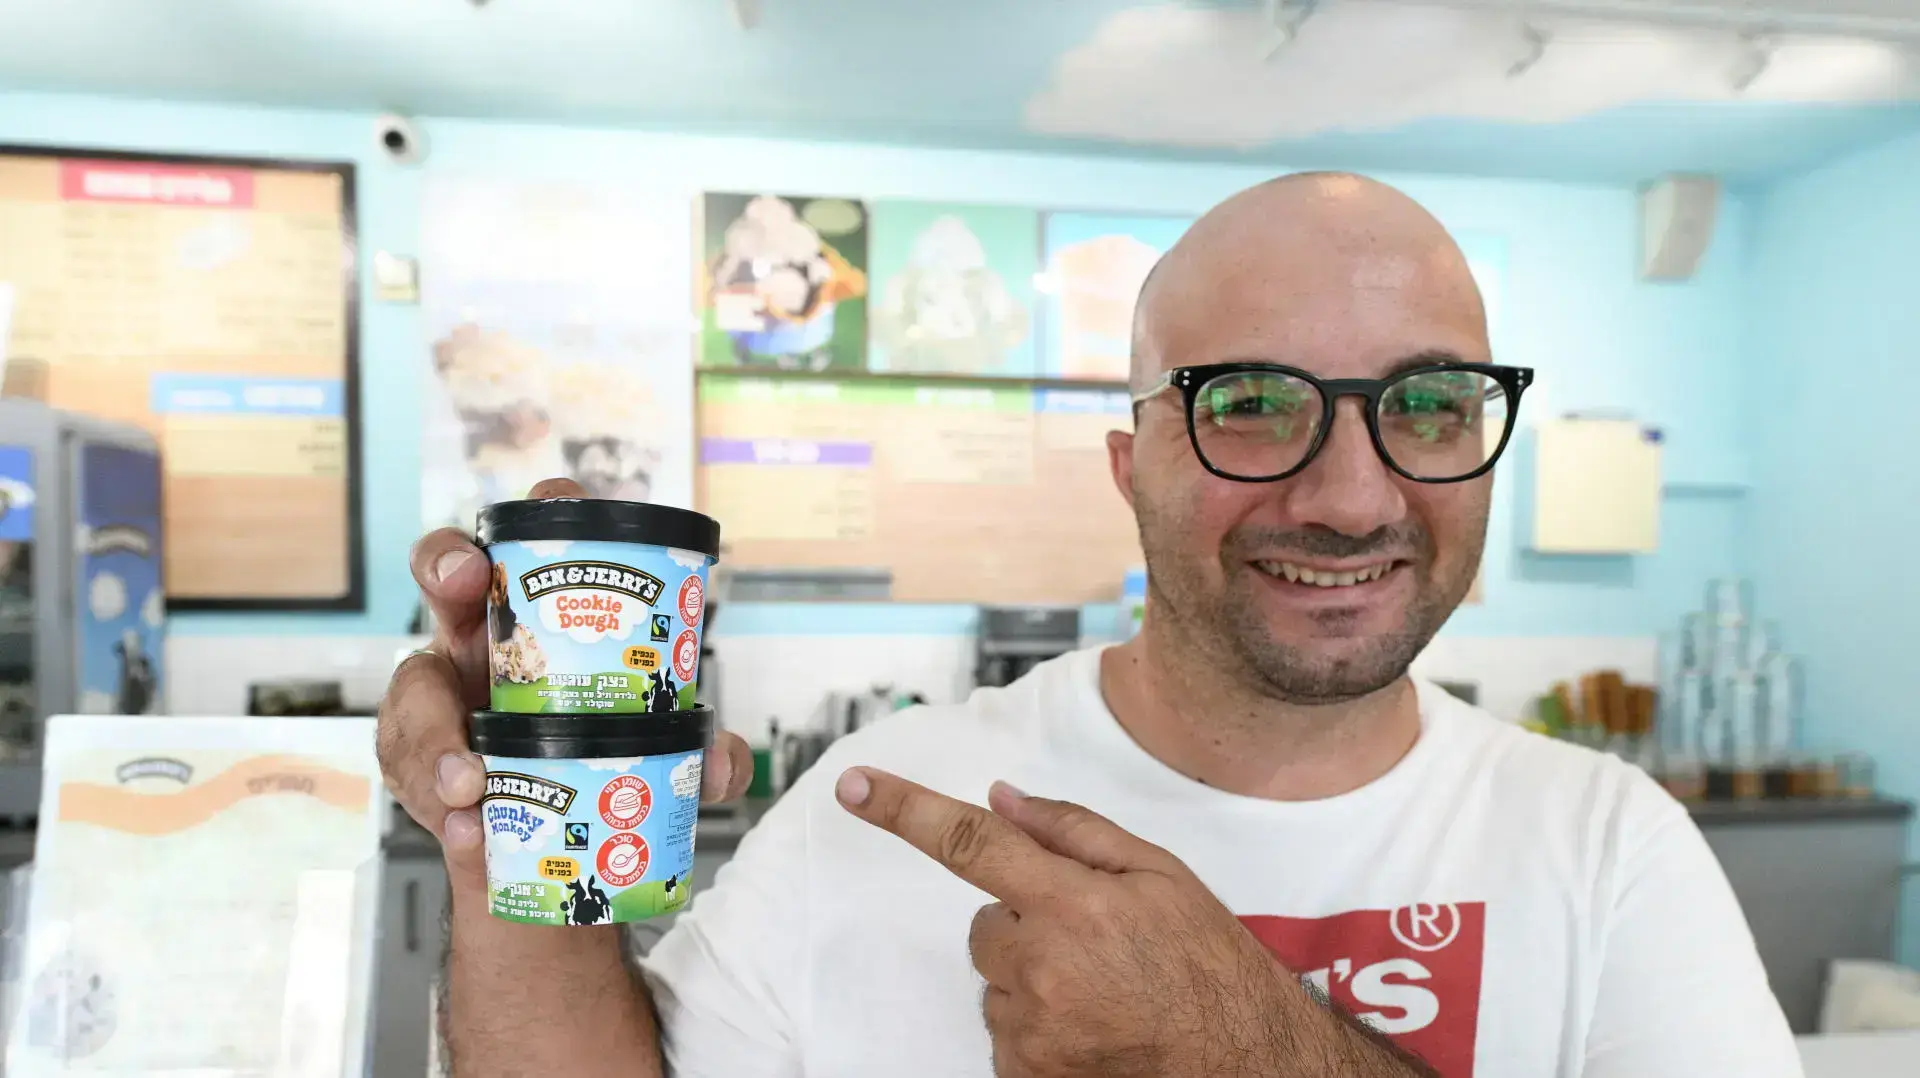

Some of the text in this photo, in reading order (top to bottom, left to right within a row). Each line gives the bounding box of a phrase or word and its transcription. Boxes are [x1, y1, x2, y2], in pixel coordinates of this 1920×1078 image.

[556, 595, 622, 613] Cookie
[558, 613, 619, 633] Dough
[597, 675, 628, 691] בצק
[621, 776, 645, 790] שומן
[487, 804, 545, 832] Chunky
[491, 821, 532, 842] Monkey
[609, 835, 634, 847] סוכר
[545, 868, 572, 877] בפנים!
[546, 860, 572, 869] הכפית
